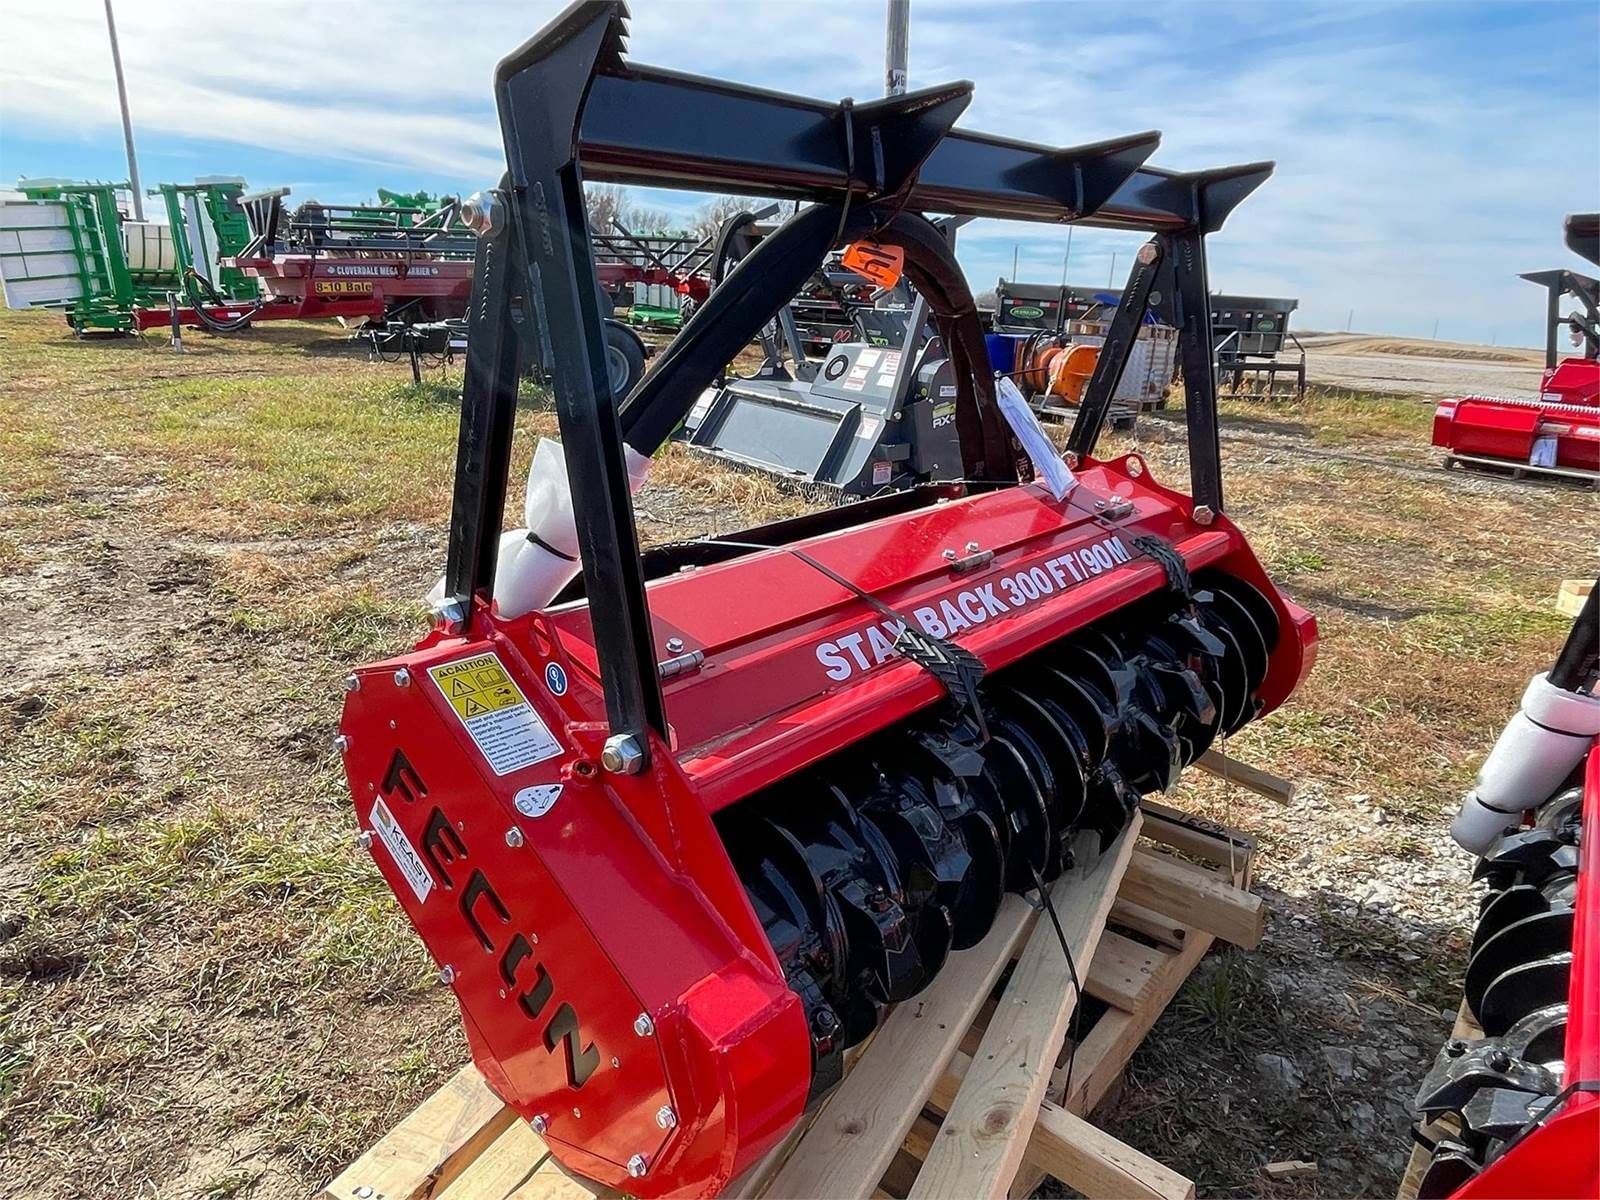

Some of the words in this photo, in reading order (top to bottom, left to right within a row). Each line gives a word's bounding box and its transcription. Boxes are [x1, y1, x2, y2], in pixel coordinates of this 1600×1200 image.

[316, 281, 342, 292] 8-10
[346, 281, 372, 292] Bale
[336, 265, 378, 276] CLOVERDALE
[380, 266, 398, 276] MEGA
[401, 266, 430, 276] ARRIER
[913, 582, 1011, 640] BACK
[1002, 567, 1054, 607] 300
[448, 657, 493, 675] CAUTION
[392, 826, 431, 883] KEAST
[381, 747, 601, 1091] FECON
